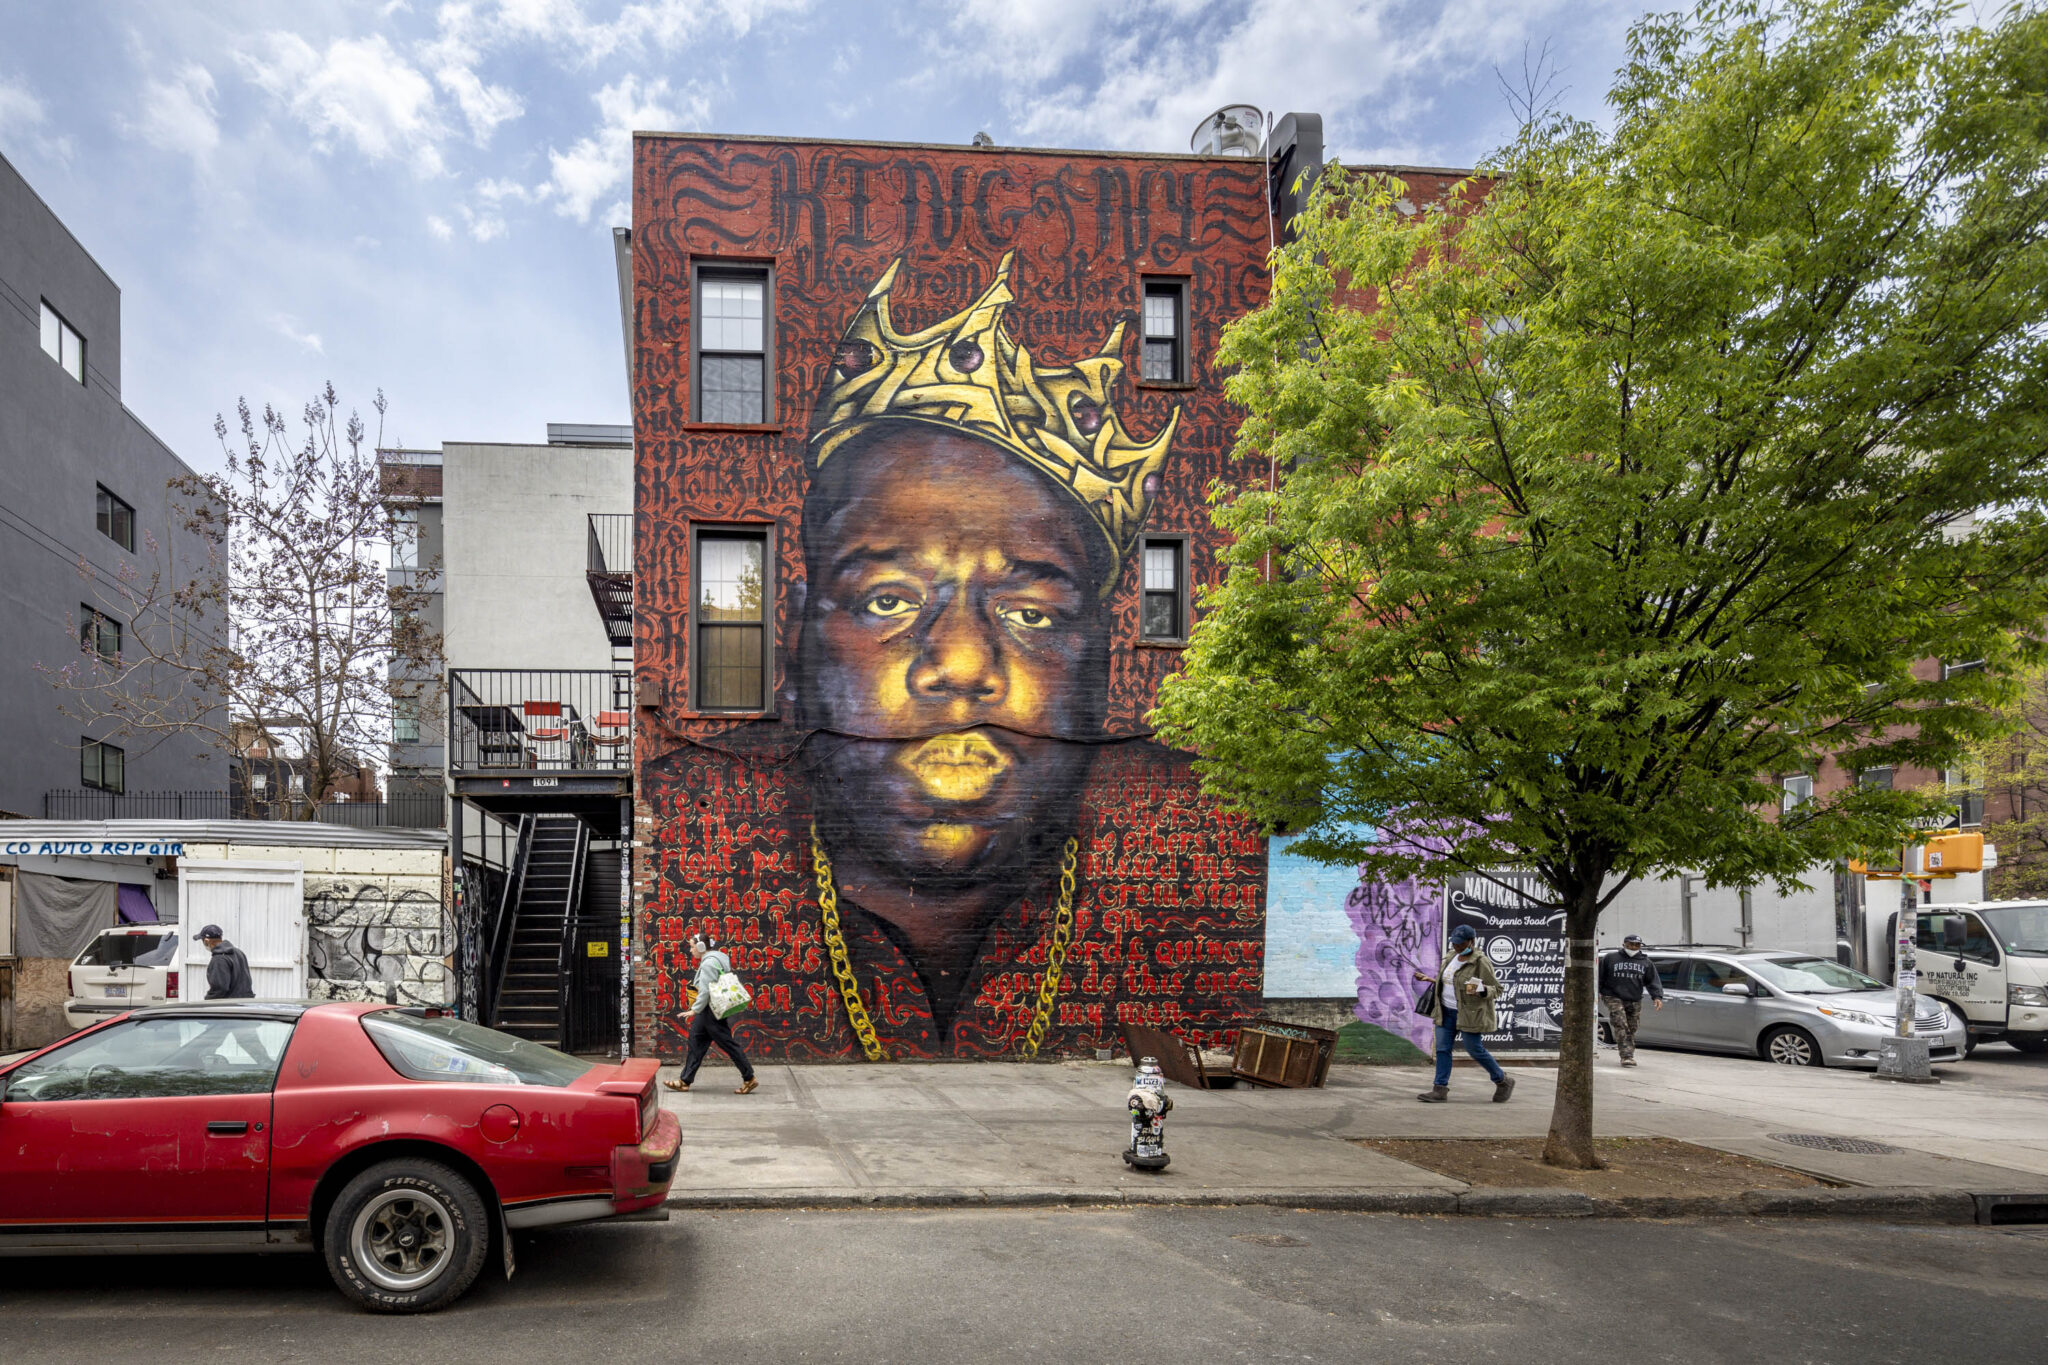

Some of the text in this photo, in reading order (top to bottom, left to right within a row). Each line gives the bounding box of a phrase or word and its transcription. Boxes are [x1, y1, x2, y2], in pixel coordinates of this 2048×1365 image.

[534, 778, 558, 786] 1091
[658, 811, 751, 846] at the
[1921, 815, 1946, 827] WAY
[6, 842, 31, 855] CO
[39, 841, 93, 855] AUTO
[1121, 826, 1209, 856] others
[660, 845, 738, 885] right
[1465, 877, 1520, 909] NATURAL
[1103, 907, 1144, 933] on
[1489, 915, 1547, 929] Organic Food
[1517, 937, 1550, 953] JUST
[1613, 962, 1646, 975] RUSSELL
[1936, 972, 1965, 980] NATURAL
[1966, 972, 1978, 980] INC
[1081, 960, 1118, 996] do
[1517, 984, 1541, 994] FROM
[1543, 984, 1561, 994] THE
[384, 1177, 466, 1231] FIREHAWK
[339, 1255, 366, 1290] 500
[368, 1291, 418, 1304] INDY
